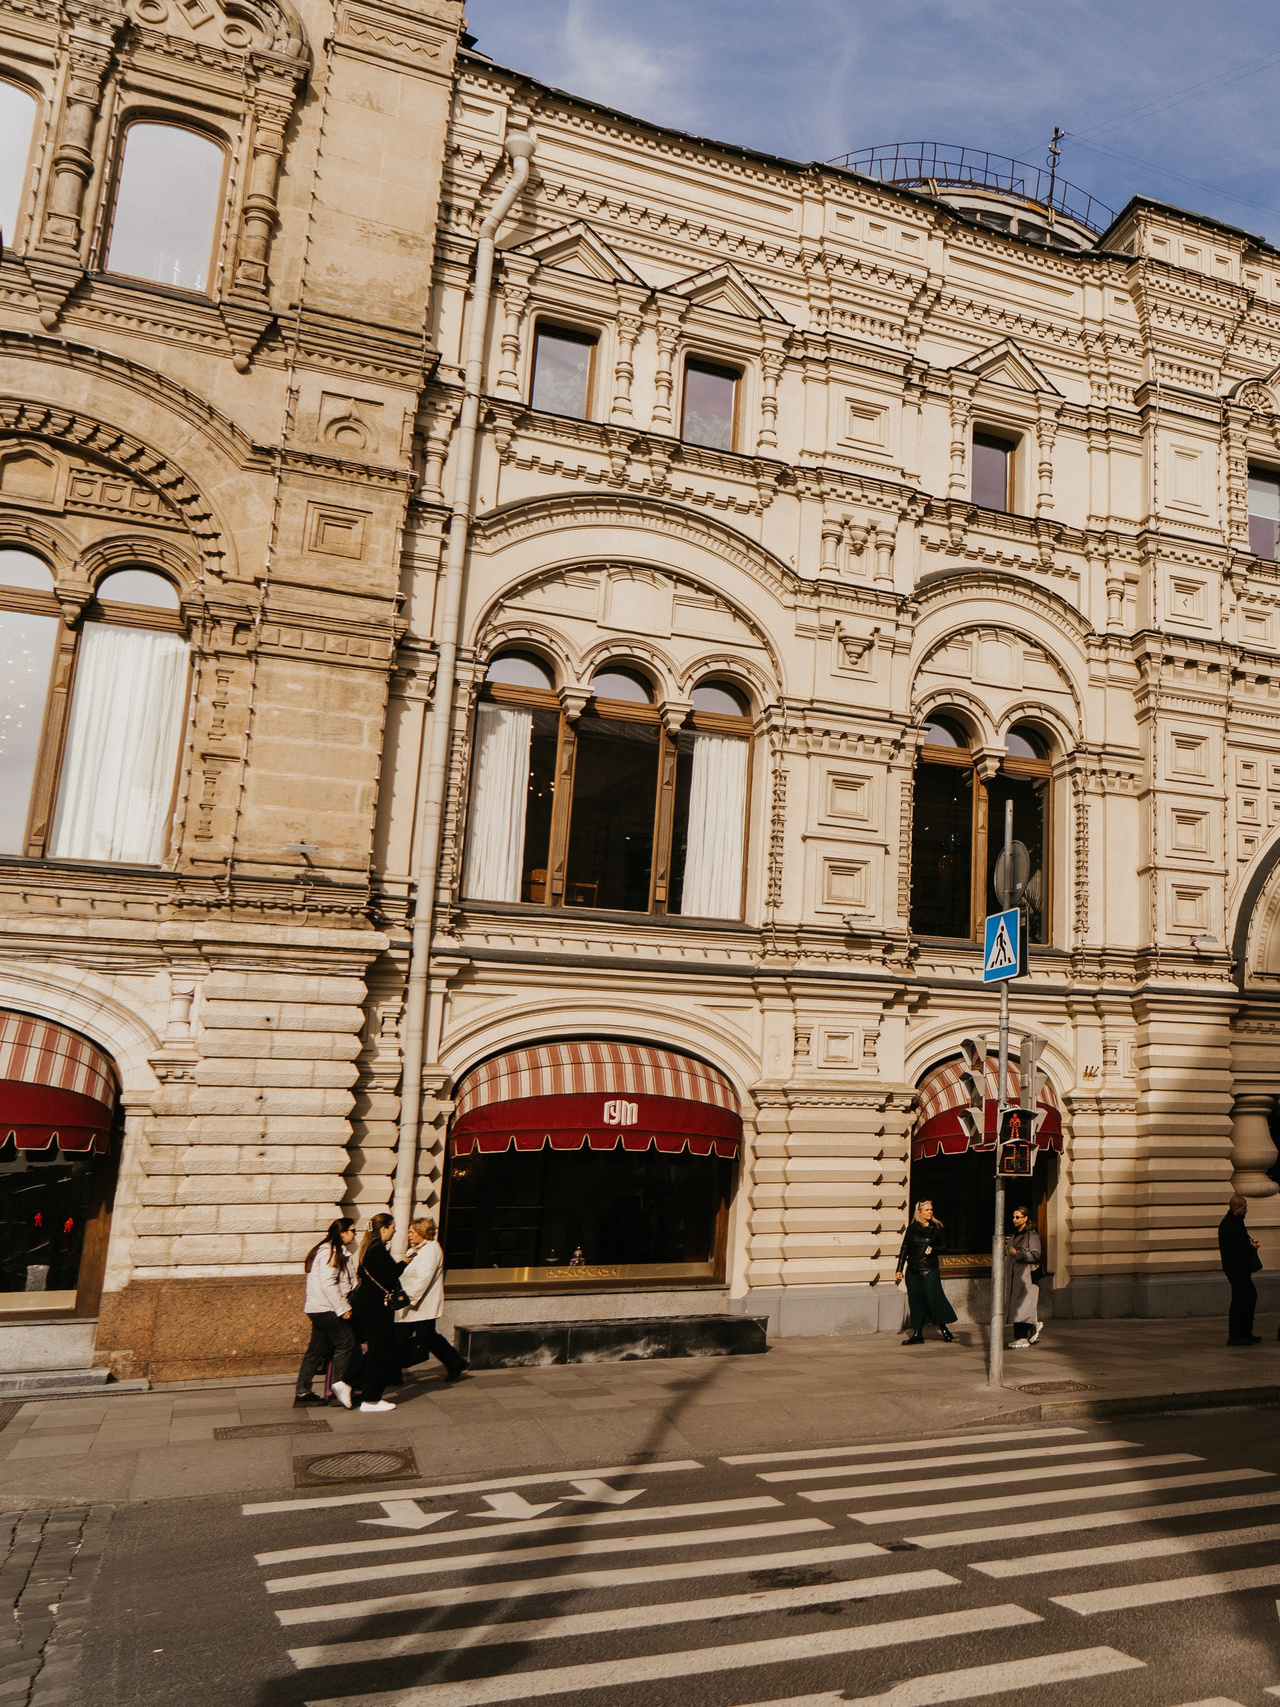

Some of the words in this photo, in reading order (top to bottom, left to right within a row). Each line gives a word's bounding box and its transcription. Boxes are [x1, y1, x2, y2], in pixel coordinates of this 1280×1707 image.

[603, 1100, 638, 1126] ГУМ
[1004, 1143, 1030, 1173] 27
[547, 1267, 582, 1278] BOSCO
[588, 1267, 618, 1277] CASA
